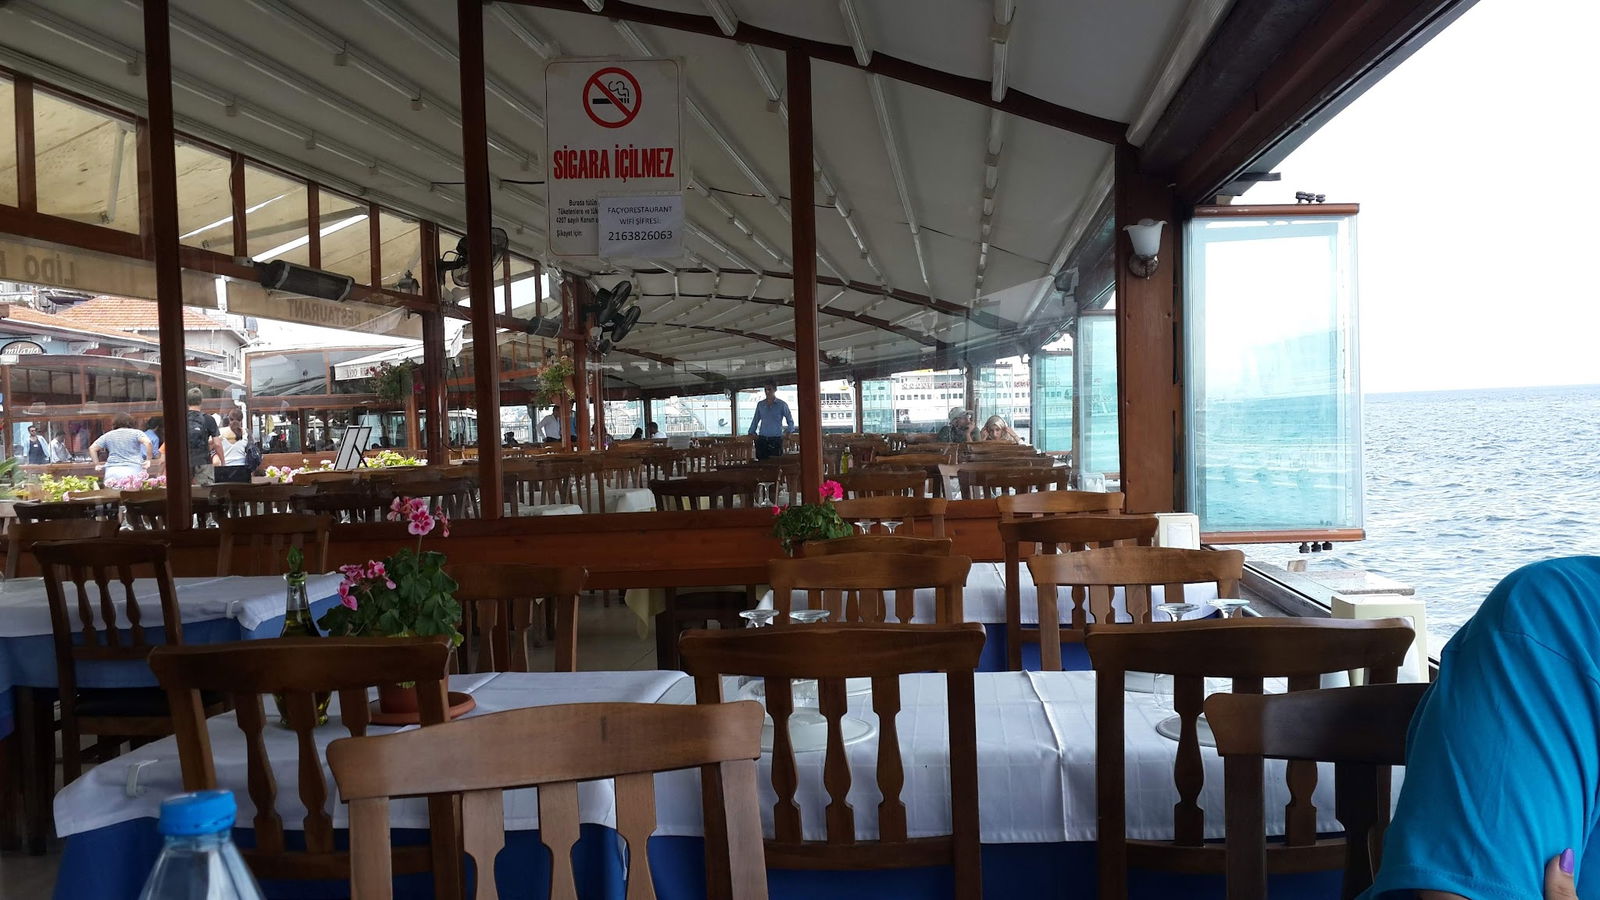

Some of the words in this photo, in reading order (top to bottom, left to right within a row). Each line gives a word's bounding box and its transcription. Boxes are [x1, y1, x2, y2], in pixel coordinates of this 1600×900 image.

[553, 145, 610, 180] SİGARA
[614, 144, 674, 183] İÇİLMEZ
[607, 206, 673, 214] FAÇYORESTAURANT
[608, 230, 673, 241] 2163826063
